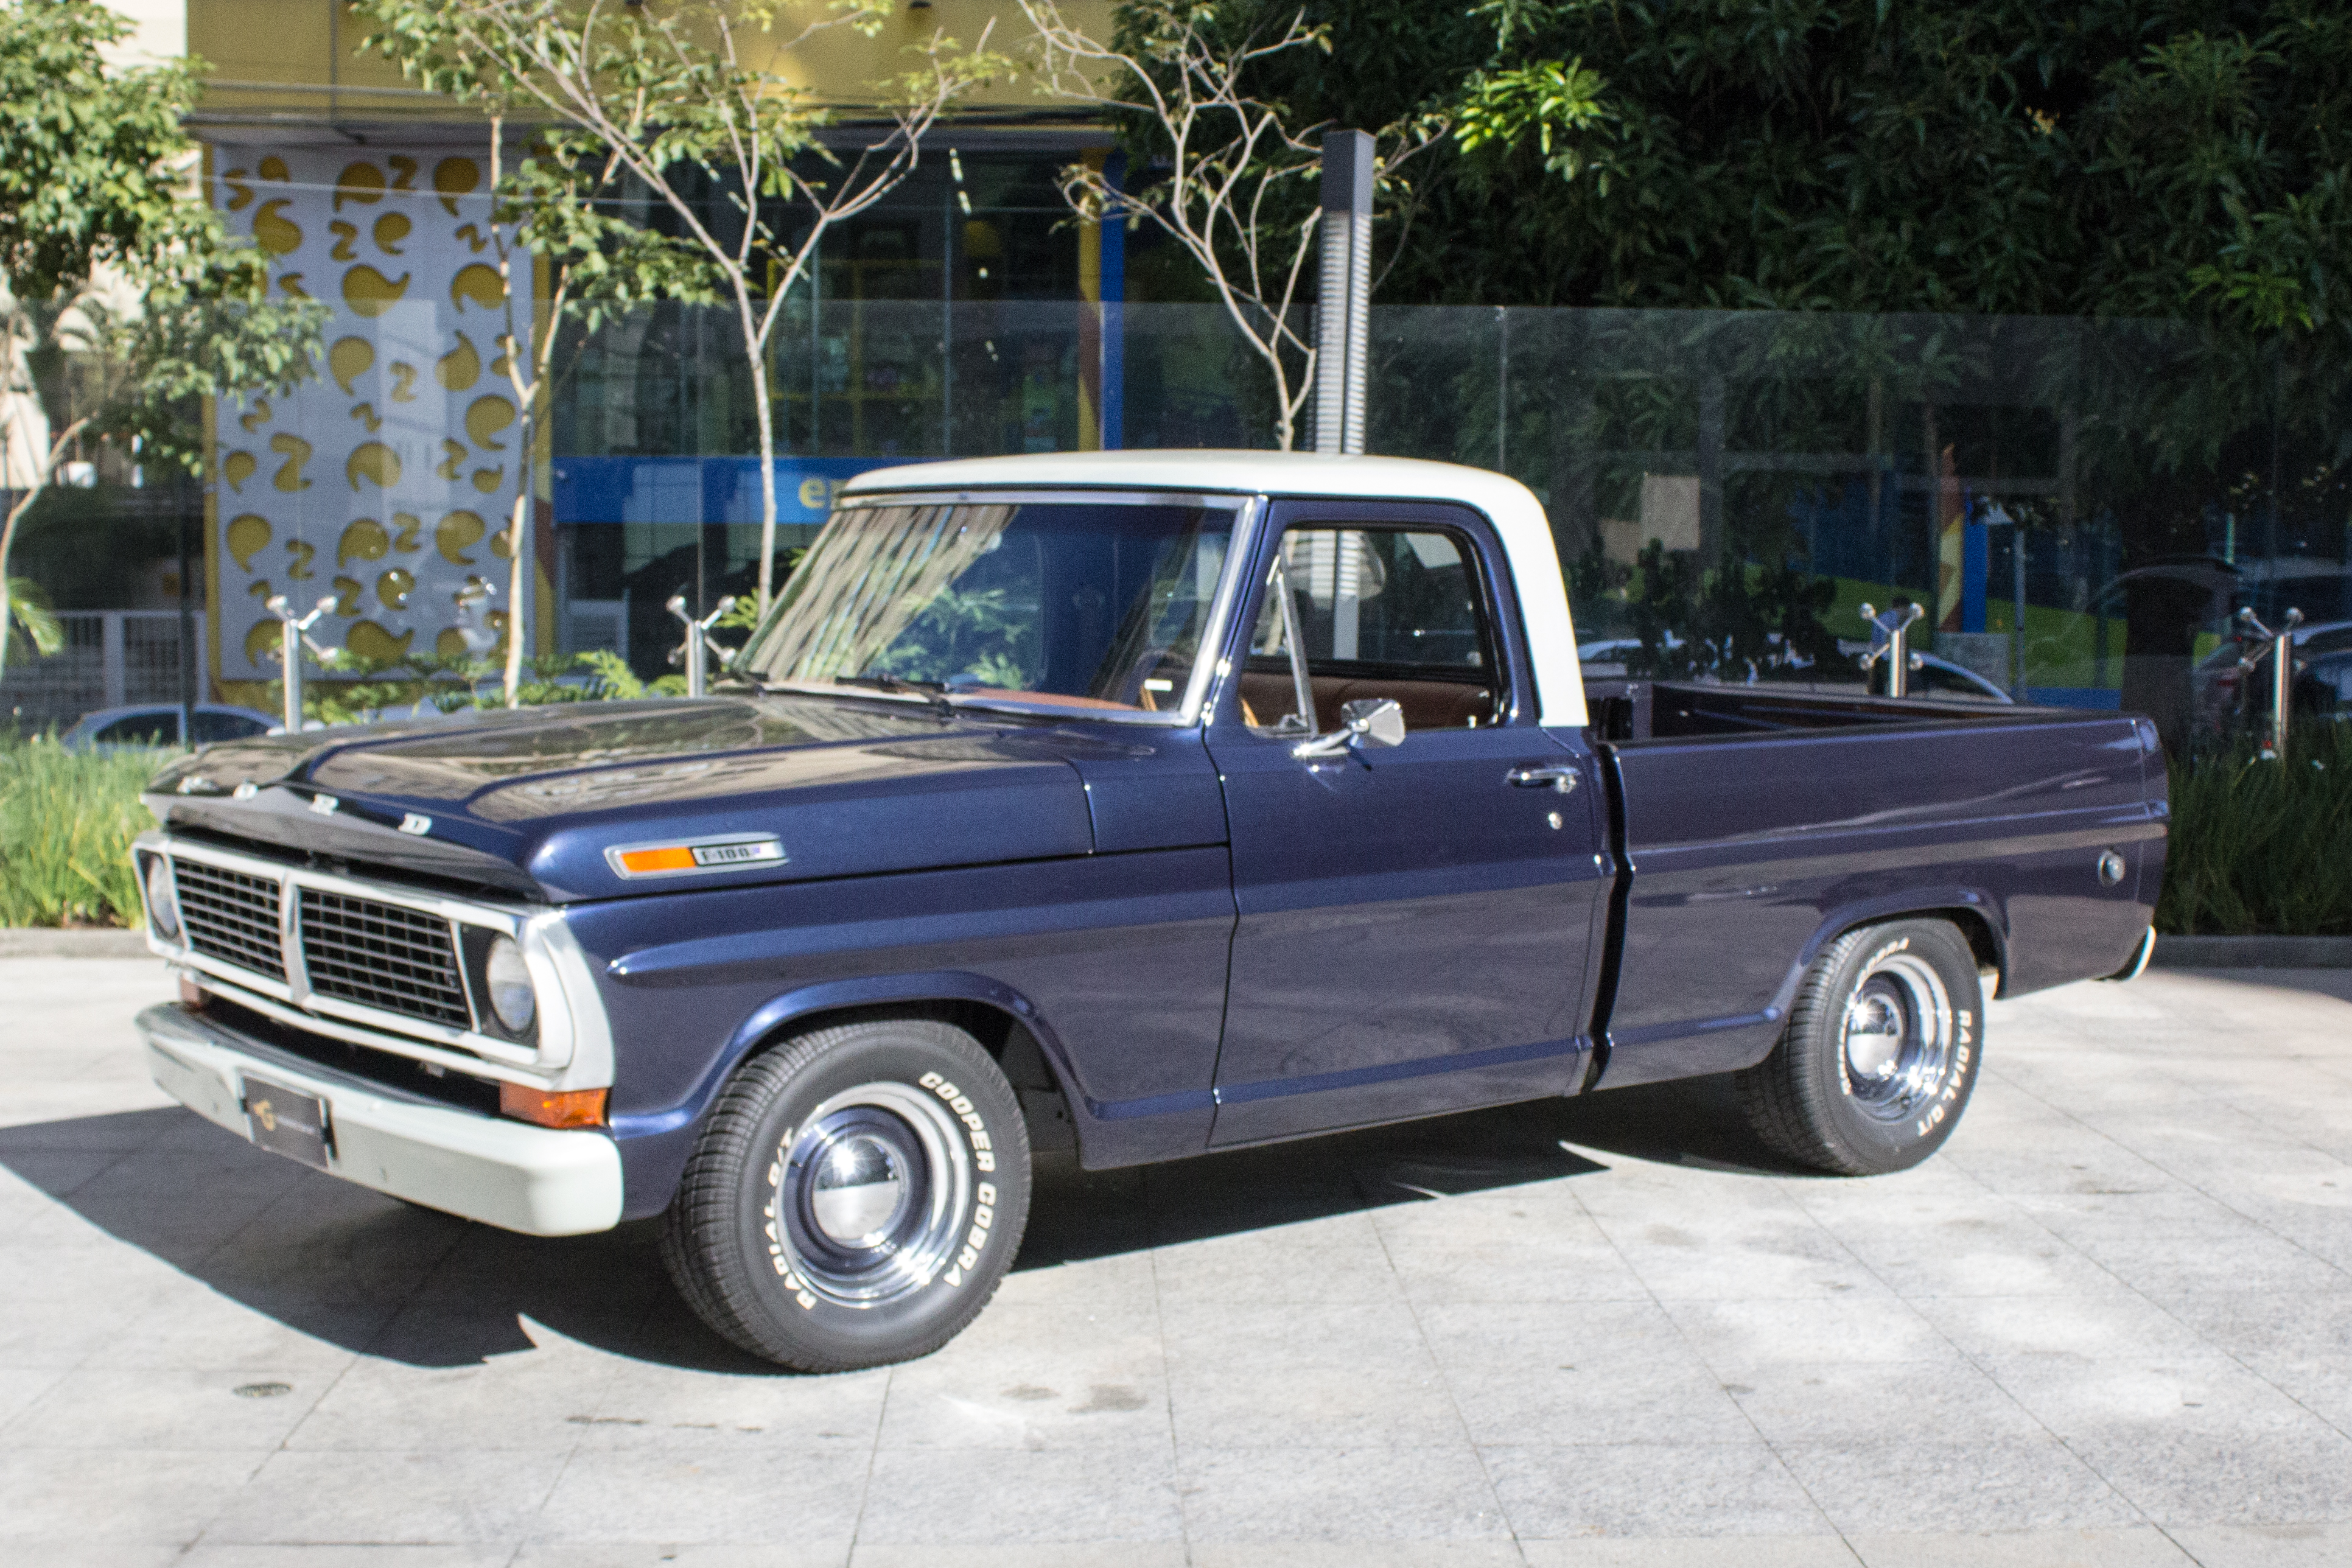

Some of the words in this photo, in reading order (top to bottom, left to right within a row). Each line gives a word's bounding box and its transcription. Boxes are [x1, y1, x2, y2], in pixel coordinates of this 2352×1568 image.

[176, 775, 433, 836] FORD
[1941, 1009, 1972, 1101] RADIAL
[919, 1071, 996, 1172] COOPER
[944, 1181, 997, 1287] COBRA
